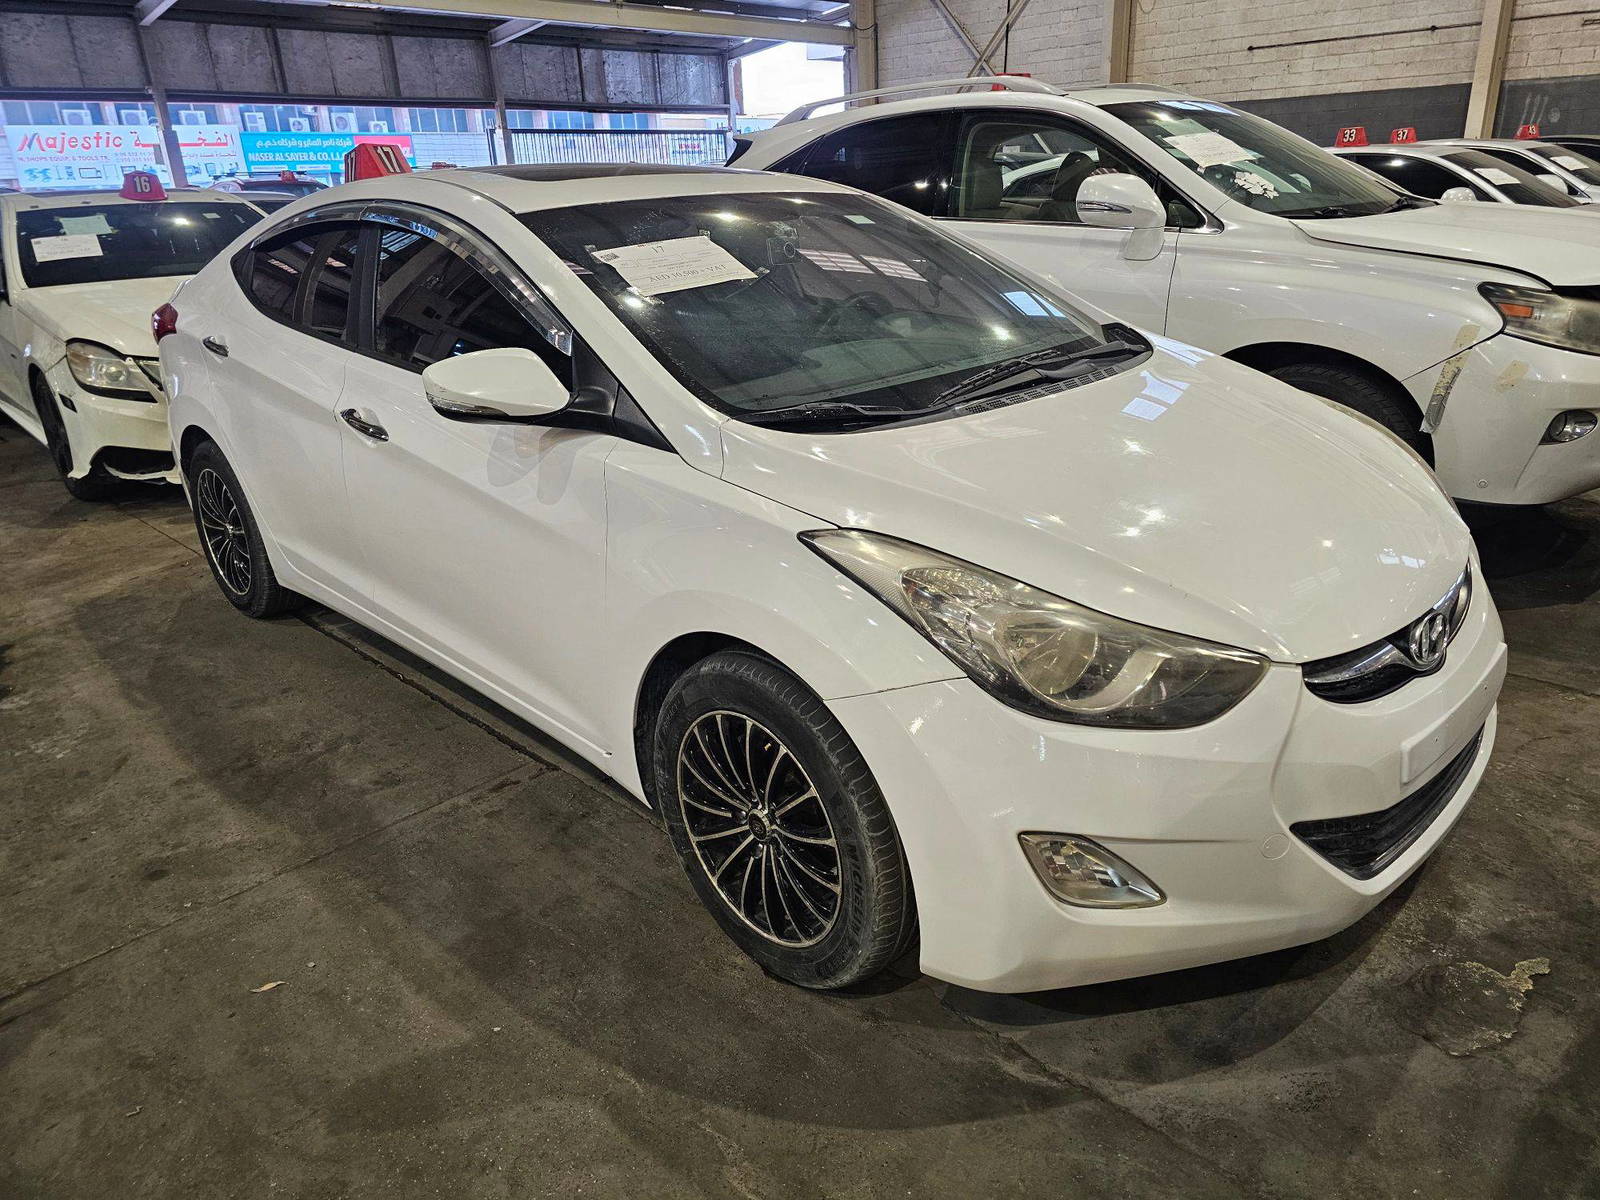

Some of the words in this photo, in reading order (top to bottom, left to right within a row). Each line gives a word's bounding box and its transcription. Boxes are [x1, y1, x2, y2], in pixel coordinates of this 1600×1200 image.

[1343, 128, 1356, 142] 33
[1396, 128, 1408, 141] 37
[18, 131, 123, 154] Majestic
[248, 152, 274, 162] NASER
[275, 152, 284, 161] AL
[284, 151, 309, 161] SAYER
[309, 151, 317, 160] &
[376, 145, 401, 173] 17
[133, 176, 151, 193] 16
[651, 244, 665, 254] 17
[846, 842, 865, 937] MICHELIN
